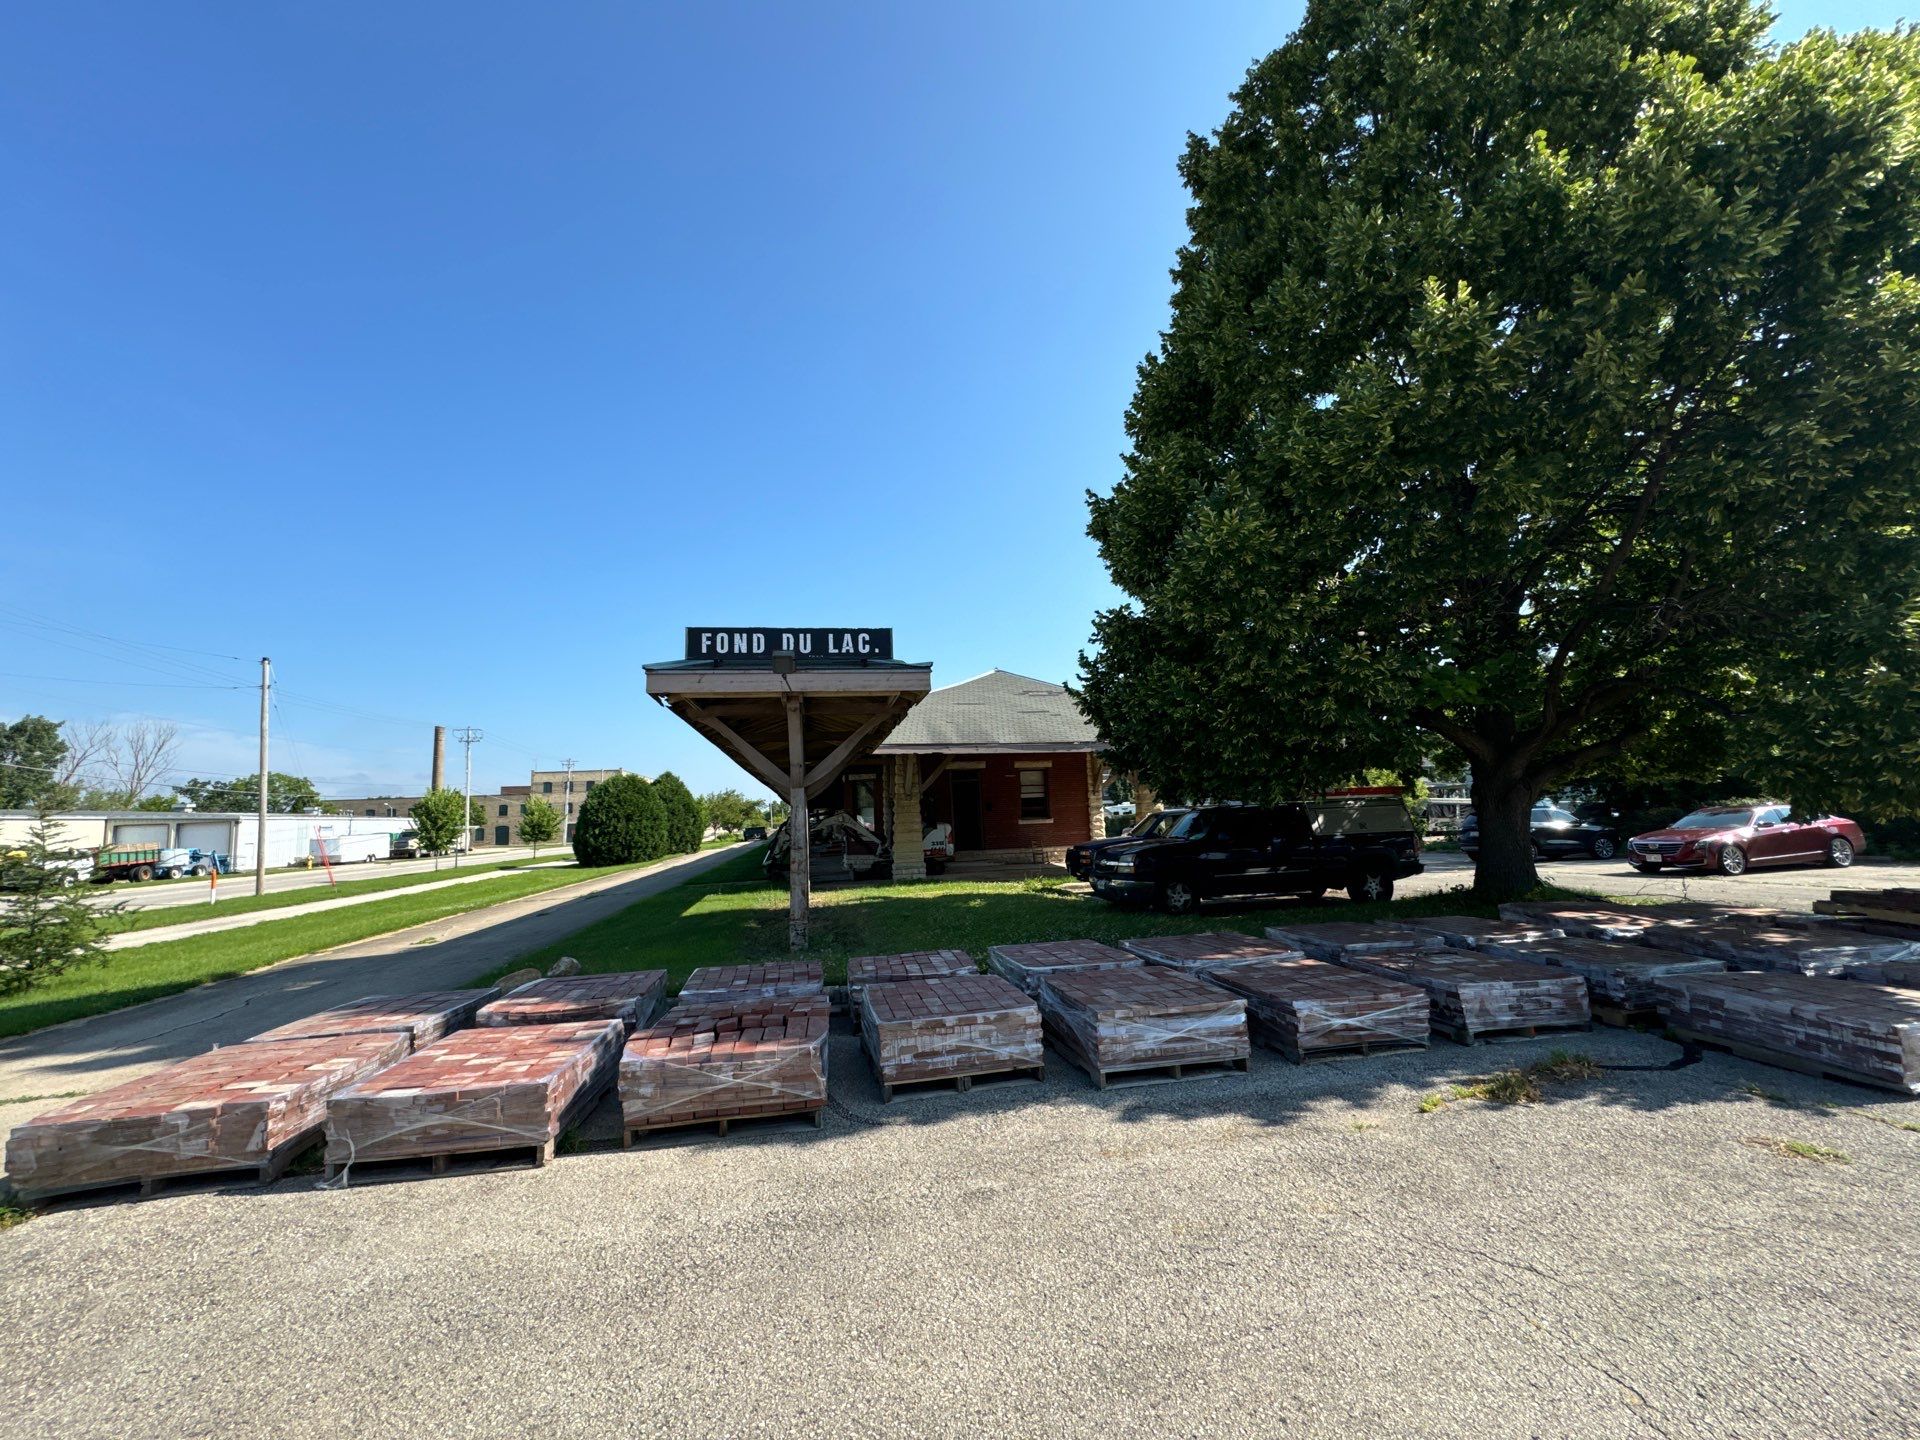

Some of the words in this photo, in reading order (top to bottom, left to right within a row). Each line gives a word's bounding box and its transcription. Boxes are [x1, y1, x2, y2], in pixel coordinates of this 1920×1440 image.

[701, 632, 765, 653] FOND
[782, 633, 811, 653] DU
[828, 633, 879, 653] LAC.
